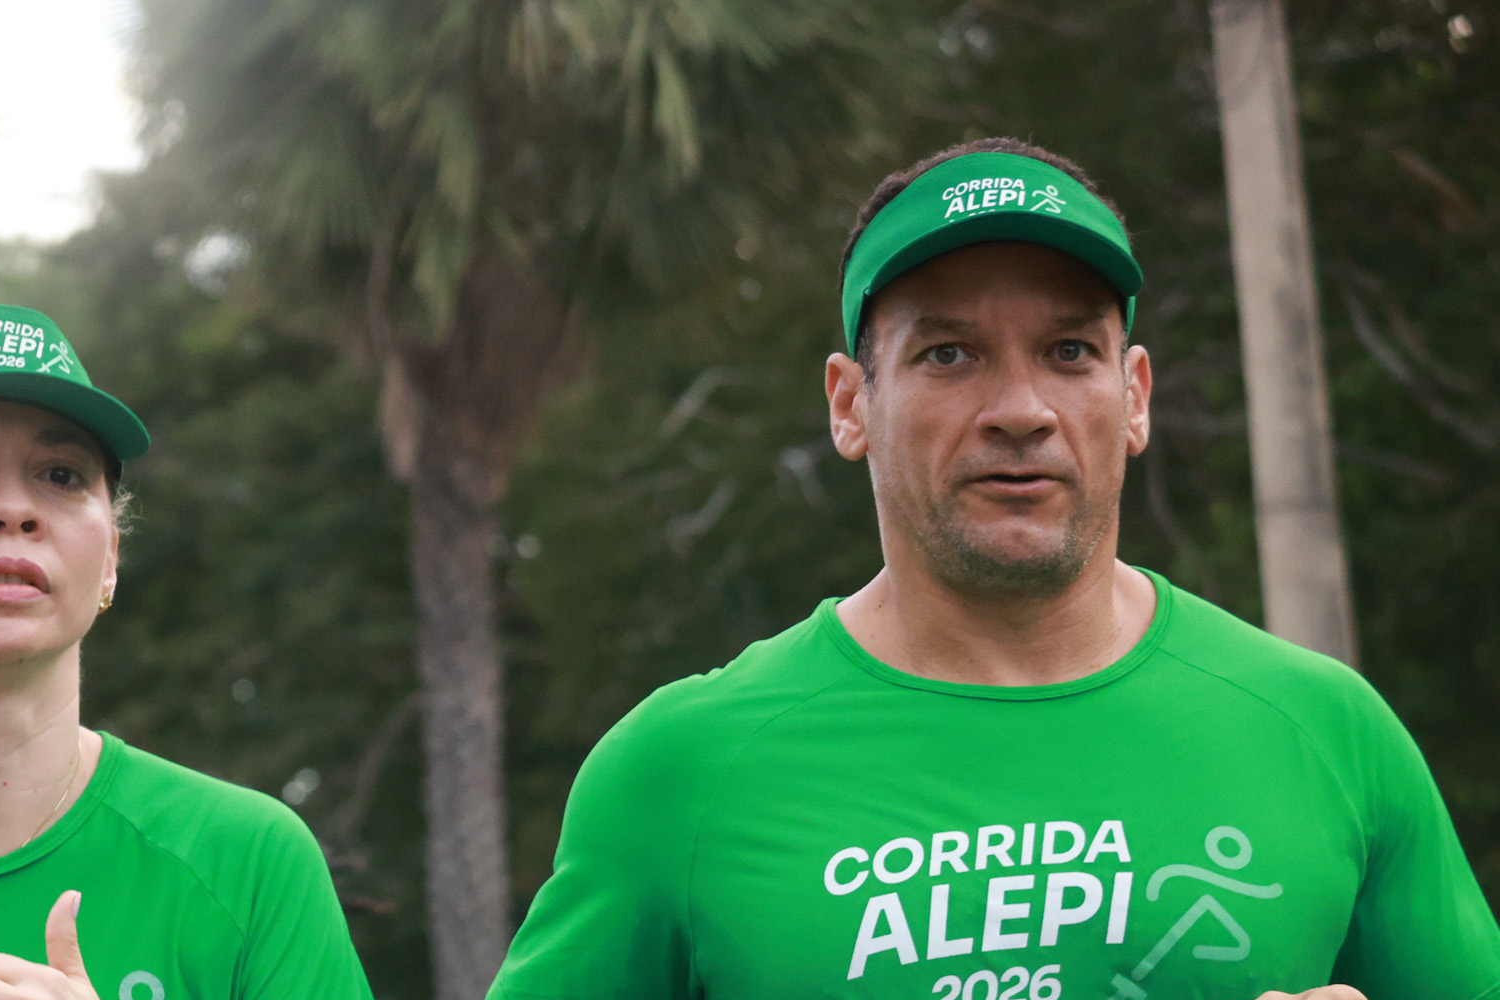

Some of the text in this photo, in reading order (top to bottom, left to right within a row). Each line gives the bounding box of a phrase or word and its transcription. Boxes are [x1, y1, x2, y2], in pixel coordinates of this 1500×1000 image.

[942, 177, 1025, 201] CORRIDA
[944, 189, 1026, 218] ALEPI
[824, 820, 1132, 896] CORRIDA
[846, 871, 1134, 981] ALEPI
